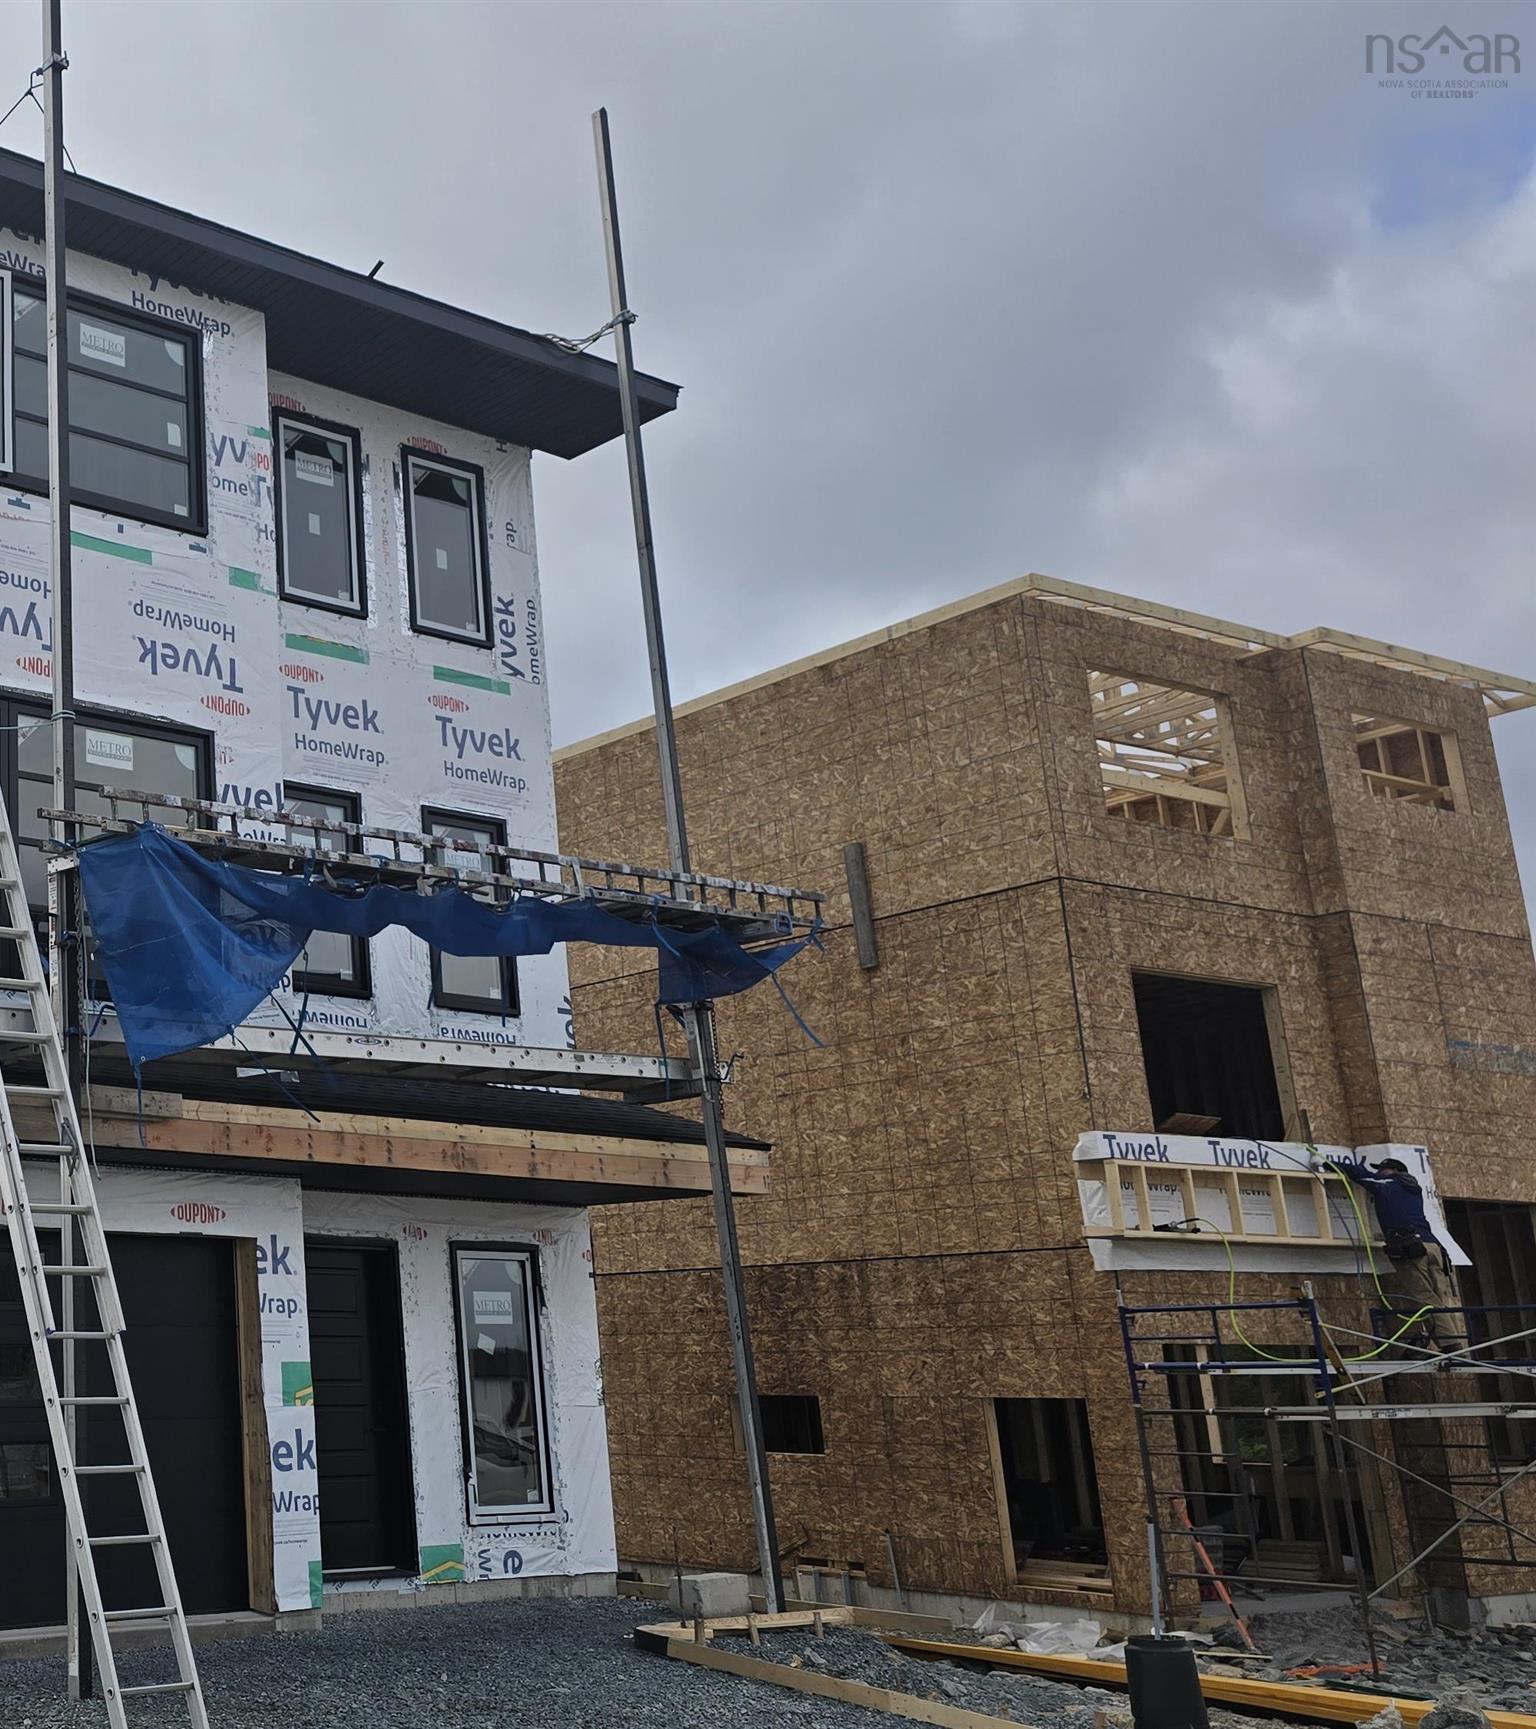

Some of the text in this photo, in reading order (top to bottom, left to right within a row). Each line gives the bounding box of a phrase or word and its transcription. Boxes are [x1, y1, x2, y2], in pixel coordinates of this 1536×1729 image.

[82, 330, 124, 353] METRO
[283, 663, 320, 683] DUPONT
[206, 695, 246, 716] DUPONT
[431, 694, 466, 713] DUPONT
[87, 737, 132, 756] METRO
[177, 1203, 221, 1223] DUPONT
[475, 1300, 511, 1311] METRO
